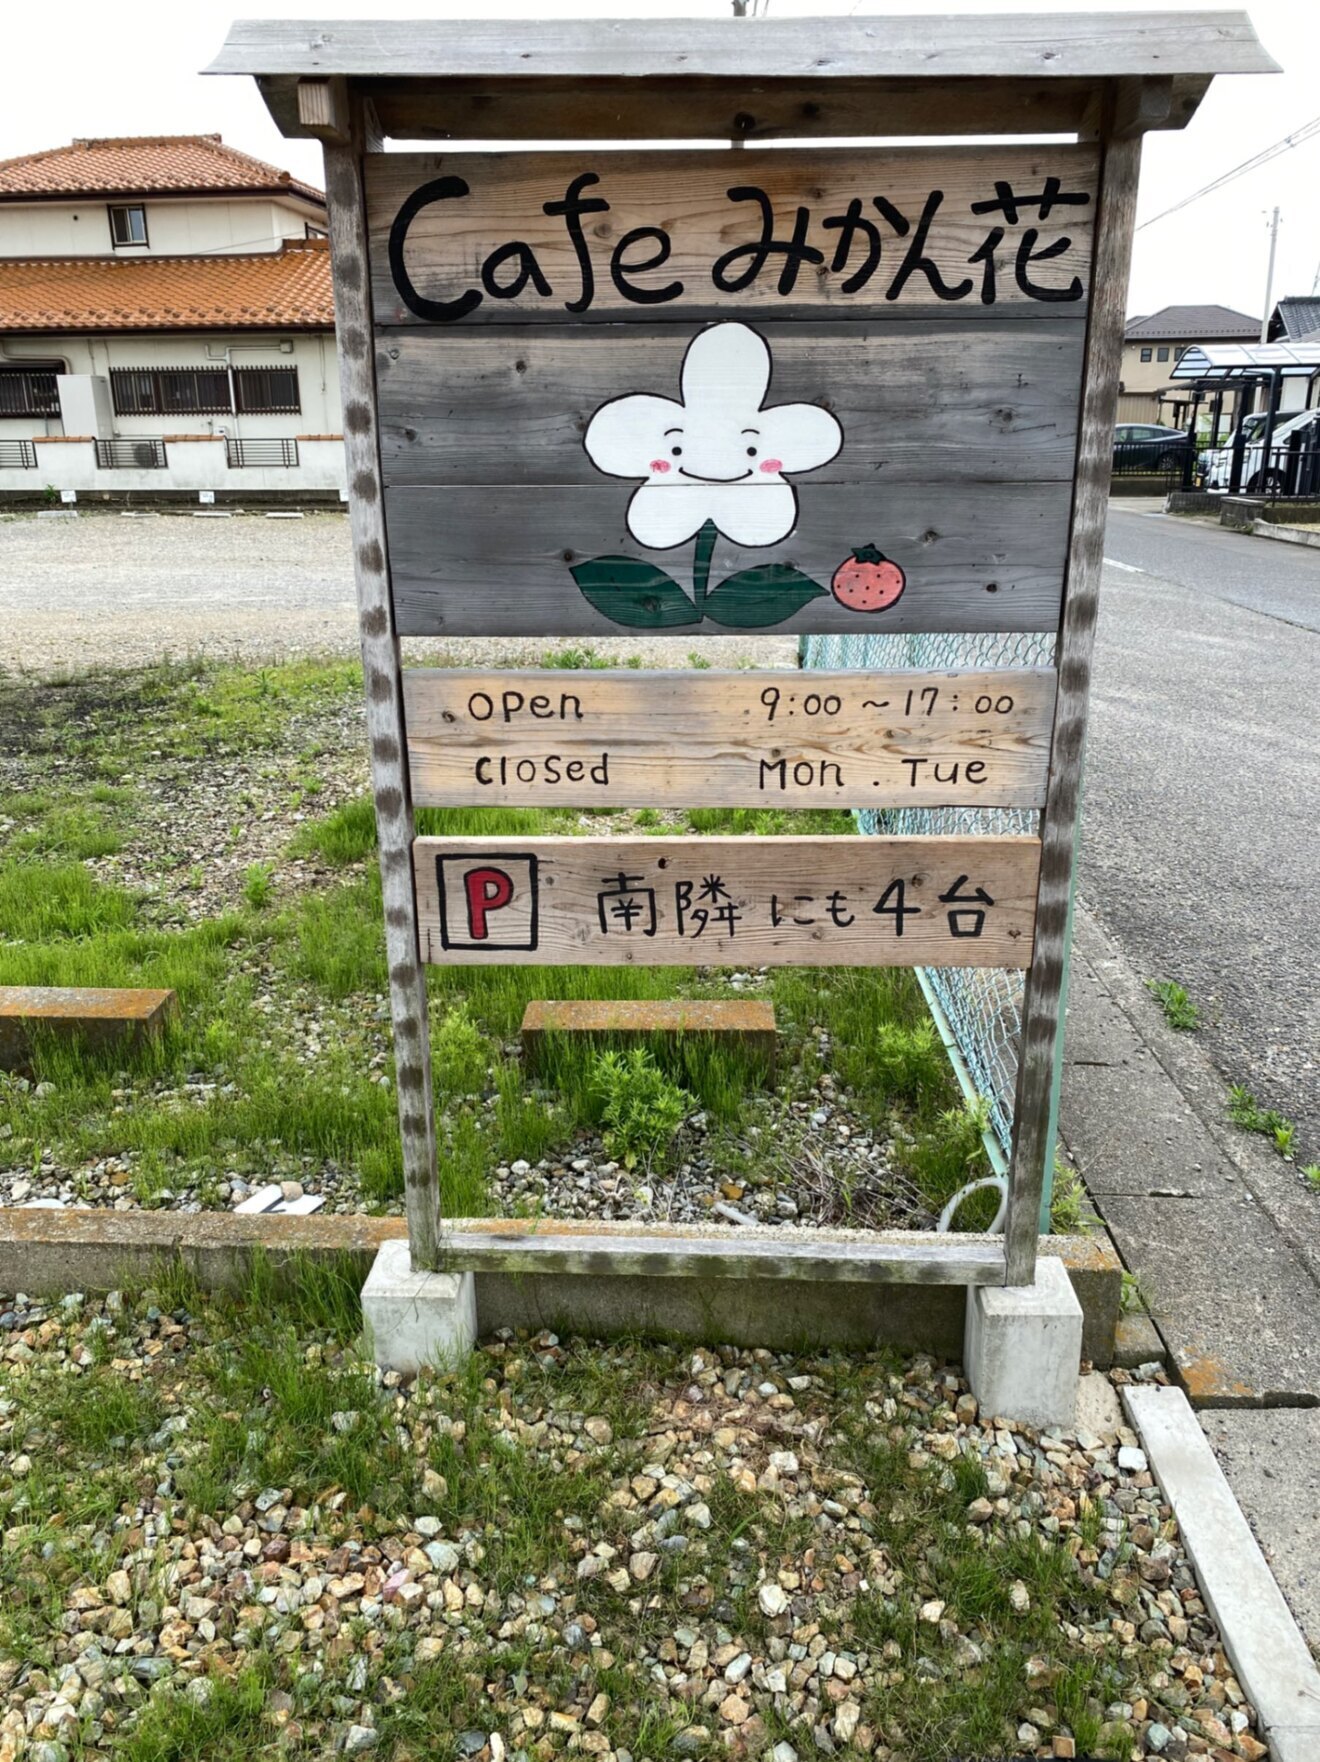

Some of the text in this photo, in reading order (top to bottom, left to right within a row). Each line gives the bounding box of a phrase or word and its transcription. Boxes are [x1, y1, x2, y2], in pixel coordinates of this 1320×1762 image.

[388, 173, 1091, 322] Cafe みかん花
[760, 686, 842, 721] 9:00
[903, 687, 1015, 717] 17:00
[901, 757, 989, 788] Tue
[462, 865, 515, 941] P
